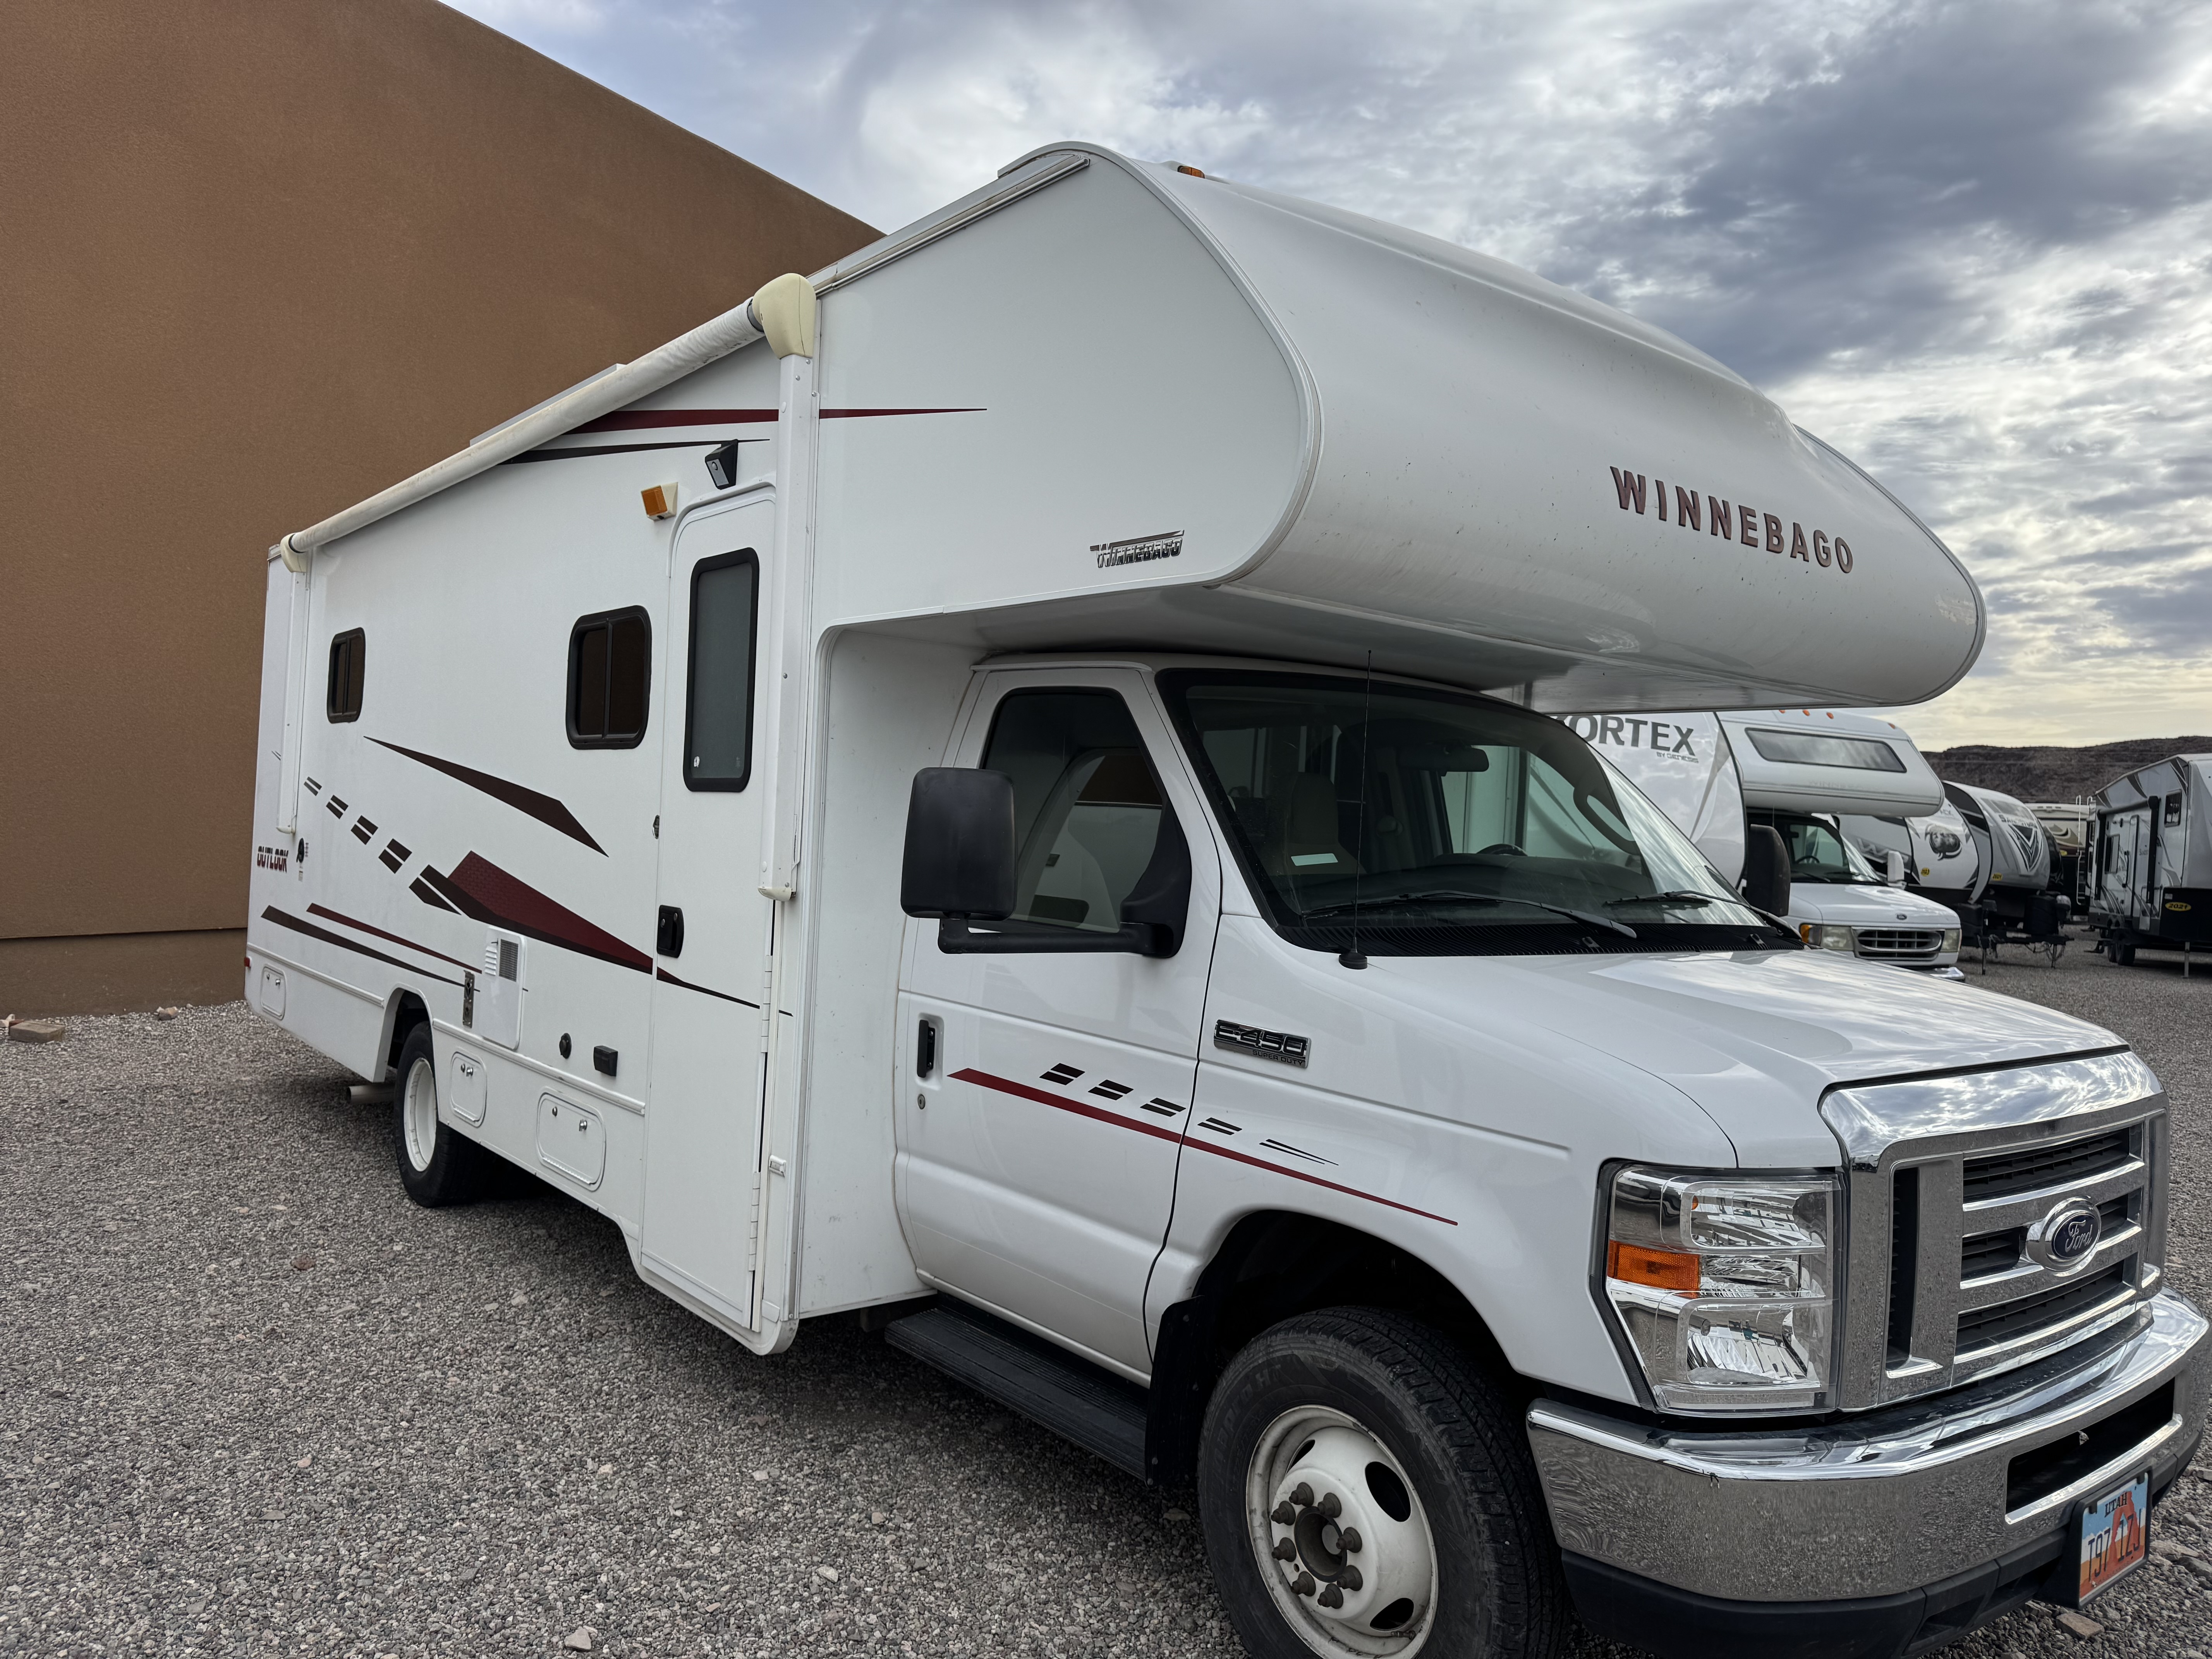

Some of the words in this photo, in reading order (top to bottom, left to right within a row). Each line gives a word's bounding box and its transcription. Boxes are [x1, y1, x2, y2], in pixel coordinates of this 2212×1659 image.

[1610, 466, 1853, 574] WINNEBAGO
[1096, 538, 1183, 568] WINNEBAGO
[1556, 715, 1695, 756] ORTEX
[257, 846, 289, 873] OUTLOOK
[1252, 1050, 1278, 1060] SUPER
[1281, 1056, 1303, 1066] DUTY
[2065, 1220, 2093, 1252] Ford
[2104, 1492, 2127, 1518] UTAH
[2088, 1528, 2111, 1582] T97
